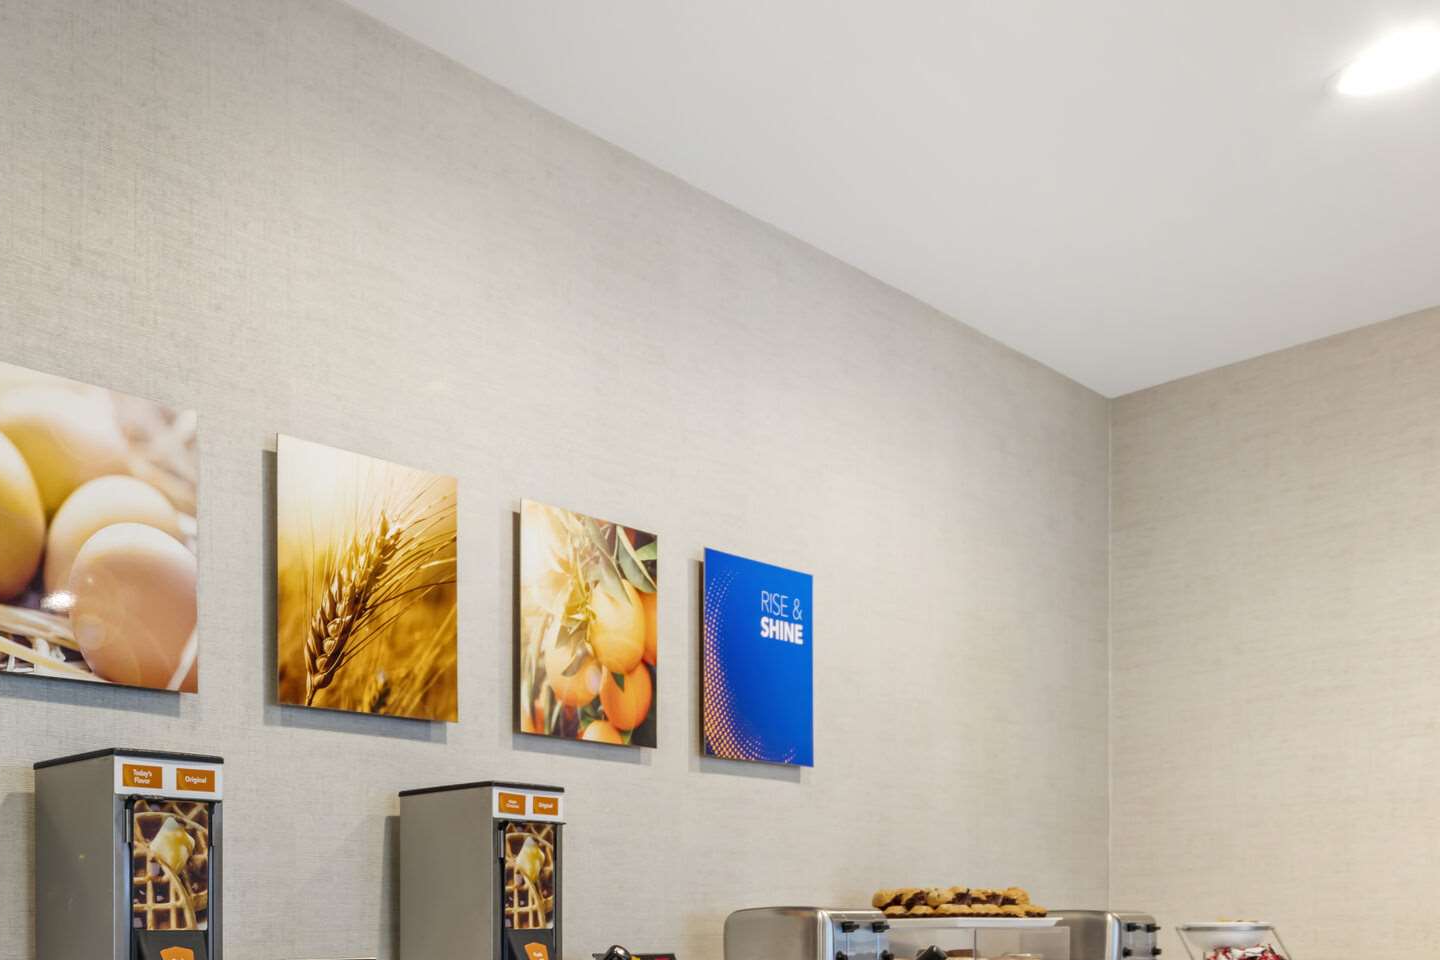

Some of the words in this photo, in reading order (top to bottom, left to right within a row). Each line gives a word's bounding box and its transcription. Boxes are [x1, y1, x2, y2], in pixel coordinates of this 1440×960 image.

[761, 590, 789, 618] RISE
[792, 598, 803, 621] &
[760, 616, 804, 645] SHINE
[133, 768, 152, 778] Today's
[184, 775, 207, 785] Original
